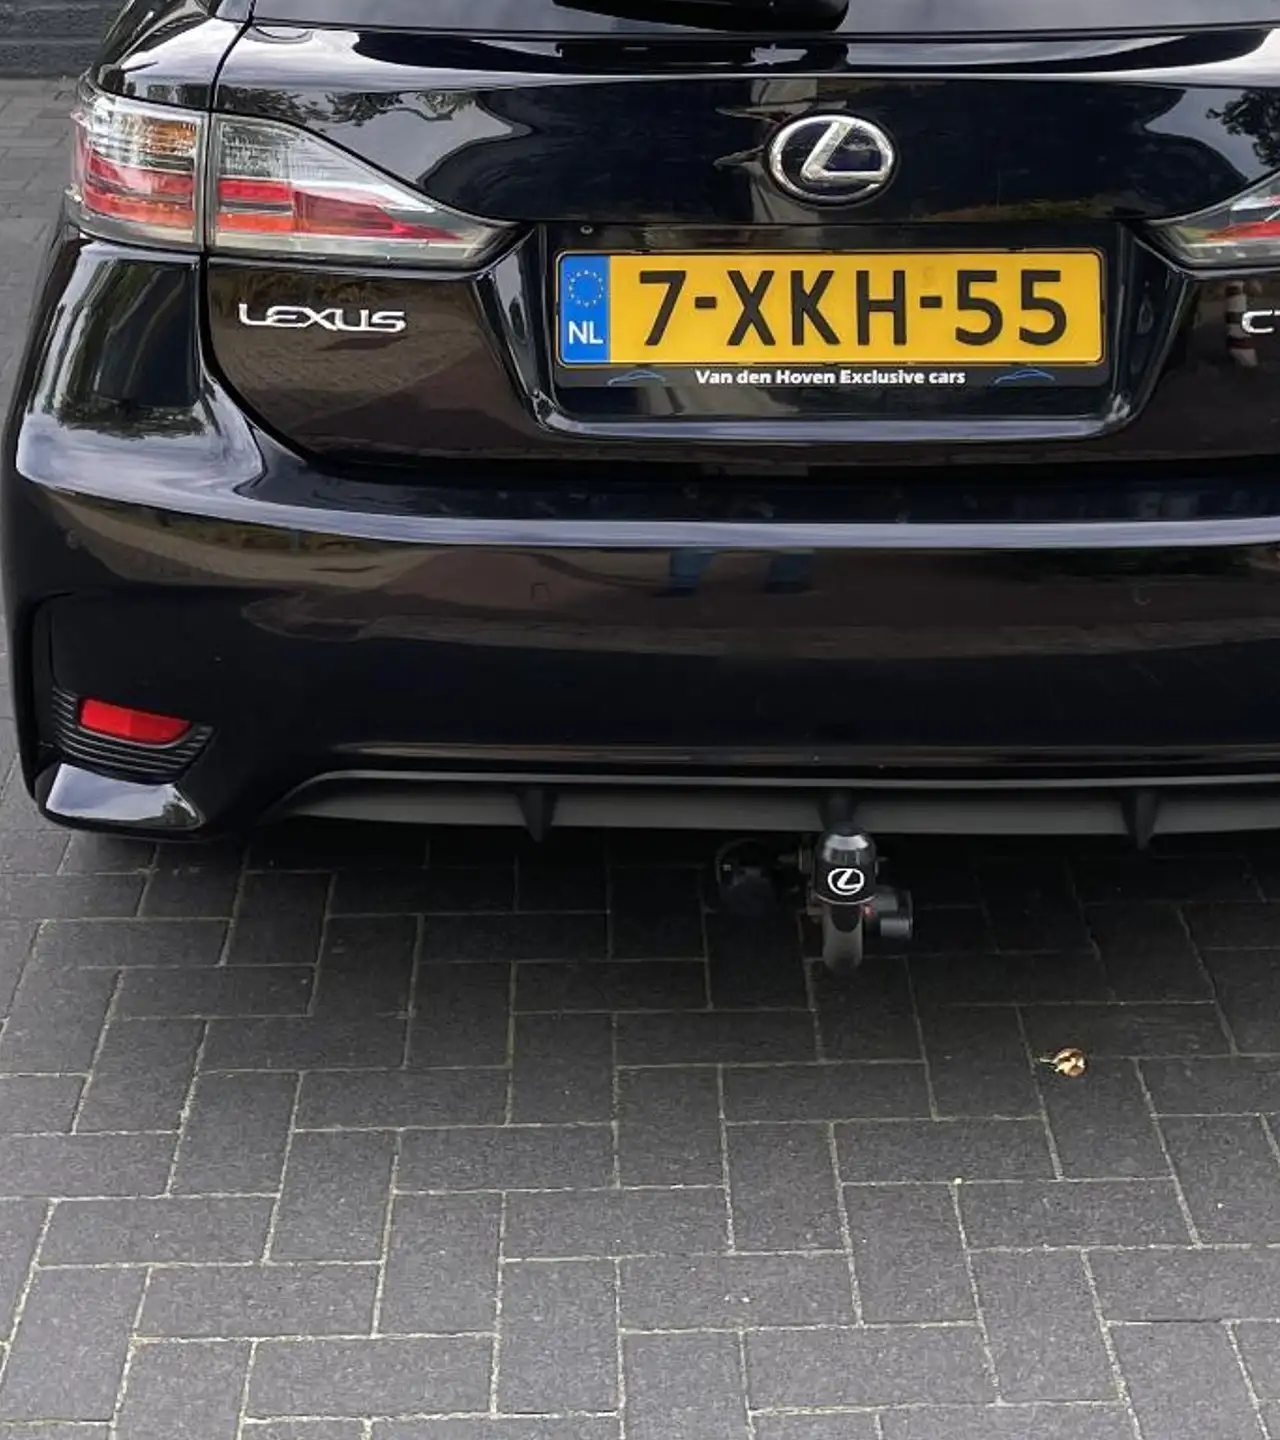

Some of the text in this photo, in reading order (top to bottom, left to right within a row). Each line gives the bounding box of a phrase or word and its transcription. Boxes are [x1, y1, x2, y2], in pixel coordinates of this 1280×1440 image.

[238, 303, 407, 334] LEXUS
[639, 270, 1067, 347] 7-XKH-55
[568, 320, 604, 346] NL
[695, 369, 966, 385] Van den Hoven Exclusive cars
